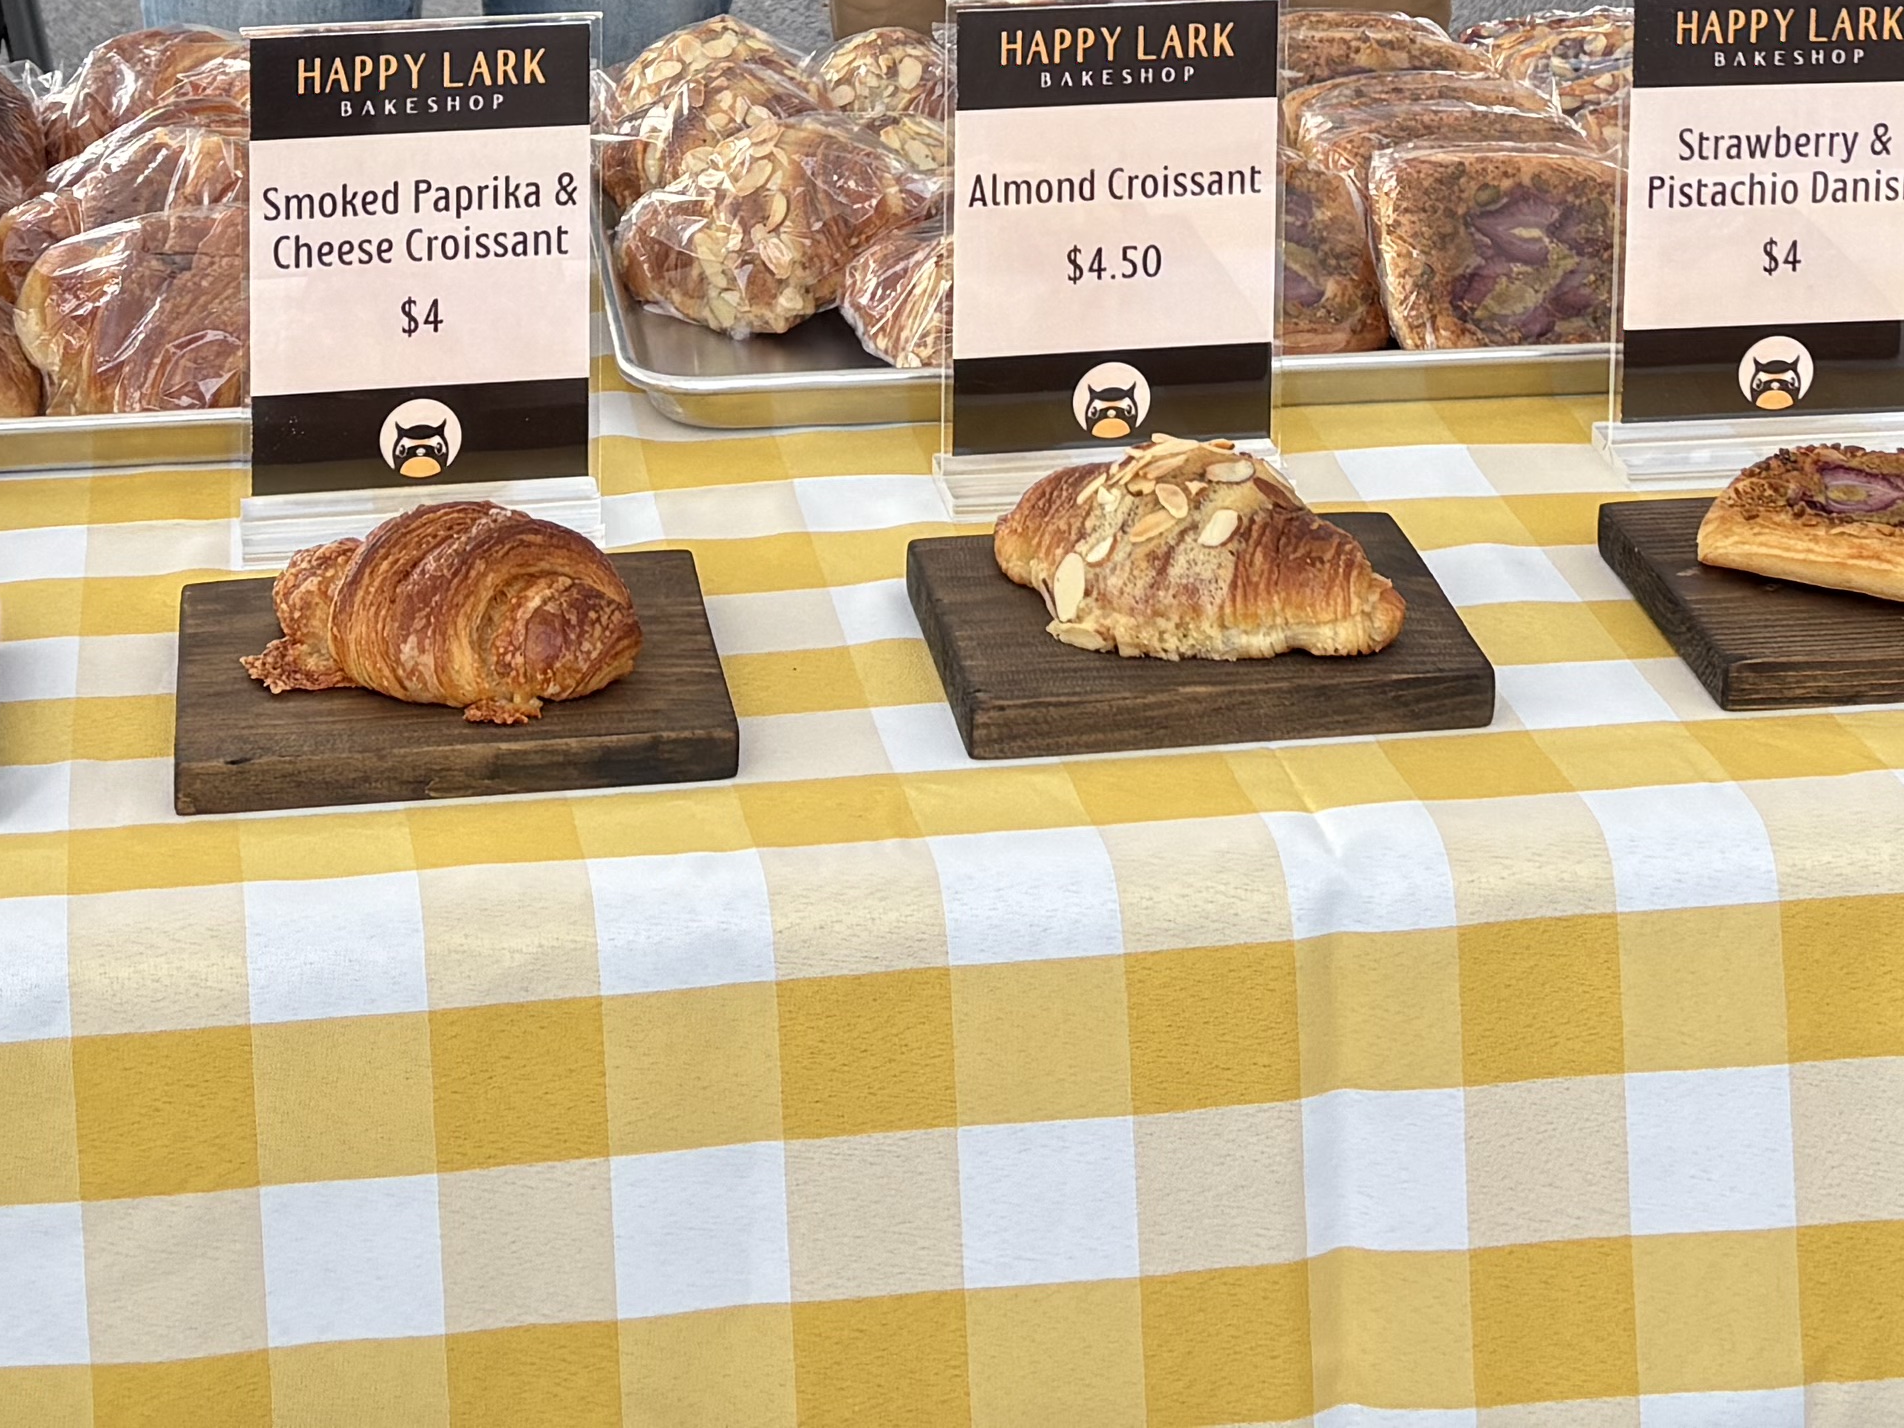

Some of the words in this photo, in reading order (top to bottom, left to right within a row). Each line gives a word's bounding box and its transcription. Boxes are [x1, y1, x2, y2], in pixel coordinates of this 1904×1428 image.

[1000, 26, 1122, 66] HAPPY
[1137, 22, 1235, 61] LARK
[1676, 8, 1795, 45] HAPPY
[1808, 5, 1904, 42] LARK
[297, 52, 426, 95] HAPPY
[443, 47, 546, 88] LARK
[1040, 65, 1195, 88] BAKESHOP
[1714, 48, 1865, 67] BAKESHOP
[340, 93, 504, 117] BAKESHOP
[1678, 125, 1859, 164] Strawberry
[1870, 122, 1892, 156] &
[262, 180, 399, 222] Smoked
[414, 175, 541, 220] Paprika
[554, 171, 578, 207] &
[968, 168, 1095, 208] Almond
[1108, 165, 1262, 201] Croissant
[1648, 171, 1799, 209] Pistachio
[273, 234, 394, 270] Cheese
[405, 225, 569, 262] Croissant
[1066, 244, 1162, 285] $4.50
[1762, 237, 1802, 277] $4
[400, 296, 444, 338] $4
